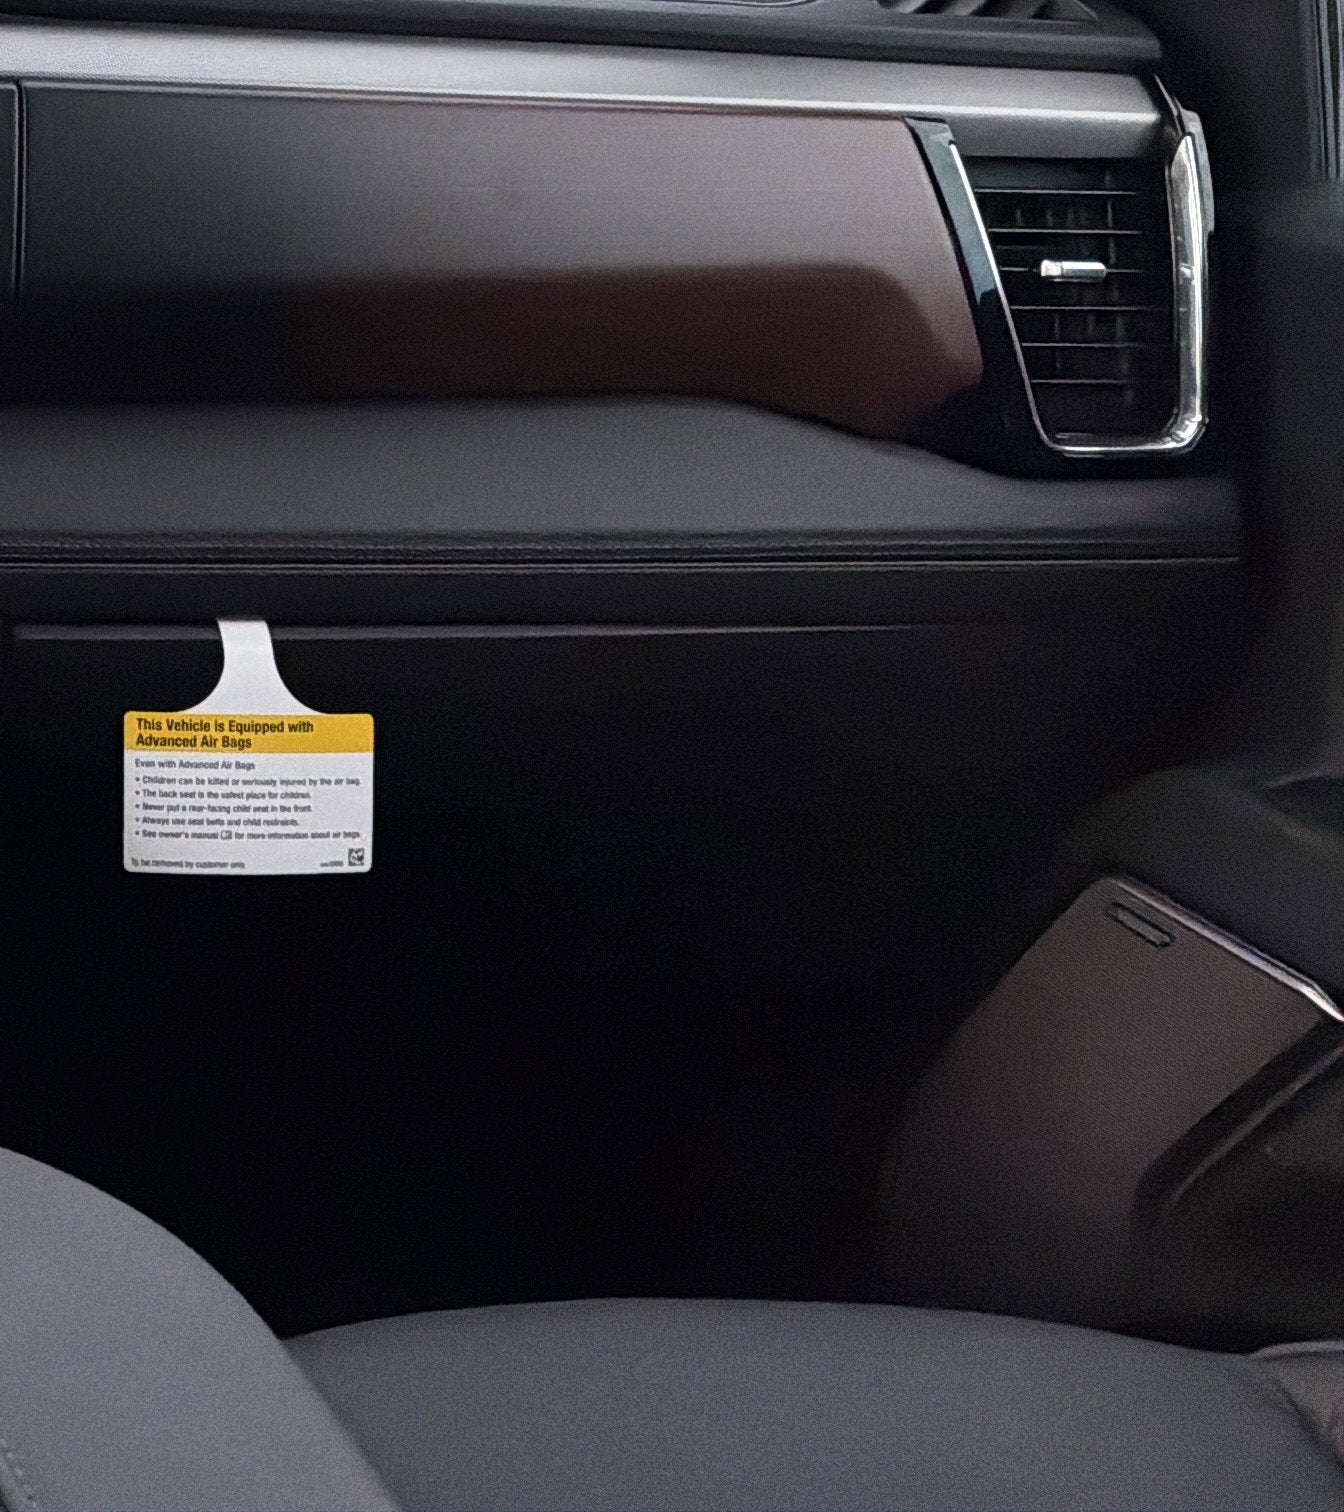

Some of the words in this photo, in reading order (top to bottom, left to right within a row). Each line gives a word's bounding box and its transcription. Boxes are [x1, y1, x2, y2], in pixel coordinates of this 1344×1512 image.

[136, 717, 162, 731] This
[166, 718, 210, 732] Vehicle
[228, 719, 284, 735] Equipped
[288, 720, 314, 733] with
[136, 733, 197, 748] Advanced
[200, 734, 219, 748] Air
[221, 735, 252, 751] Bags
[134, 758, 155, 768] Even
[158, 759, 176, 769] with
[178, 759, 219, 769] Advanced
[221, 760, 233, 770] Air
[235, 760, 256, 771] Bags
[142, 776, 176, 785] Children
[179, 777, 193, 785] can
[195, 777, 205, 785] be
[208, 777, 229, 786] killed
[309, 778, 317, 787] by
[320, 778, 332, 786] the
[142, 789, 156, 798] The
[159, 789, 177, 798] back
[179, 790, 196, 798] seat
[207, 791, 219, 799] the
[246, 792, 266, 801] place
[142, 802, 164, 810] Never
[167, 804, 180, 813] put
[233, 805, 251, 813] child
[142, 817, 170, 826] Always
[188, 818, 204, 826] seat
[227, 818, 241, 826] and
[243, 818, 261, 826] child
[142, 829, 156, 838] See
[158, 831, 189, 839] owner's
[235, 831, 244, 839] for
